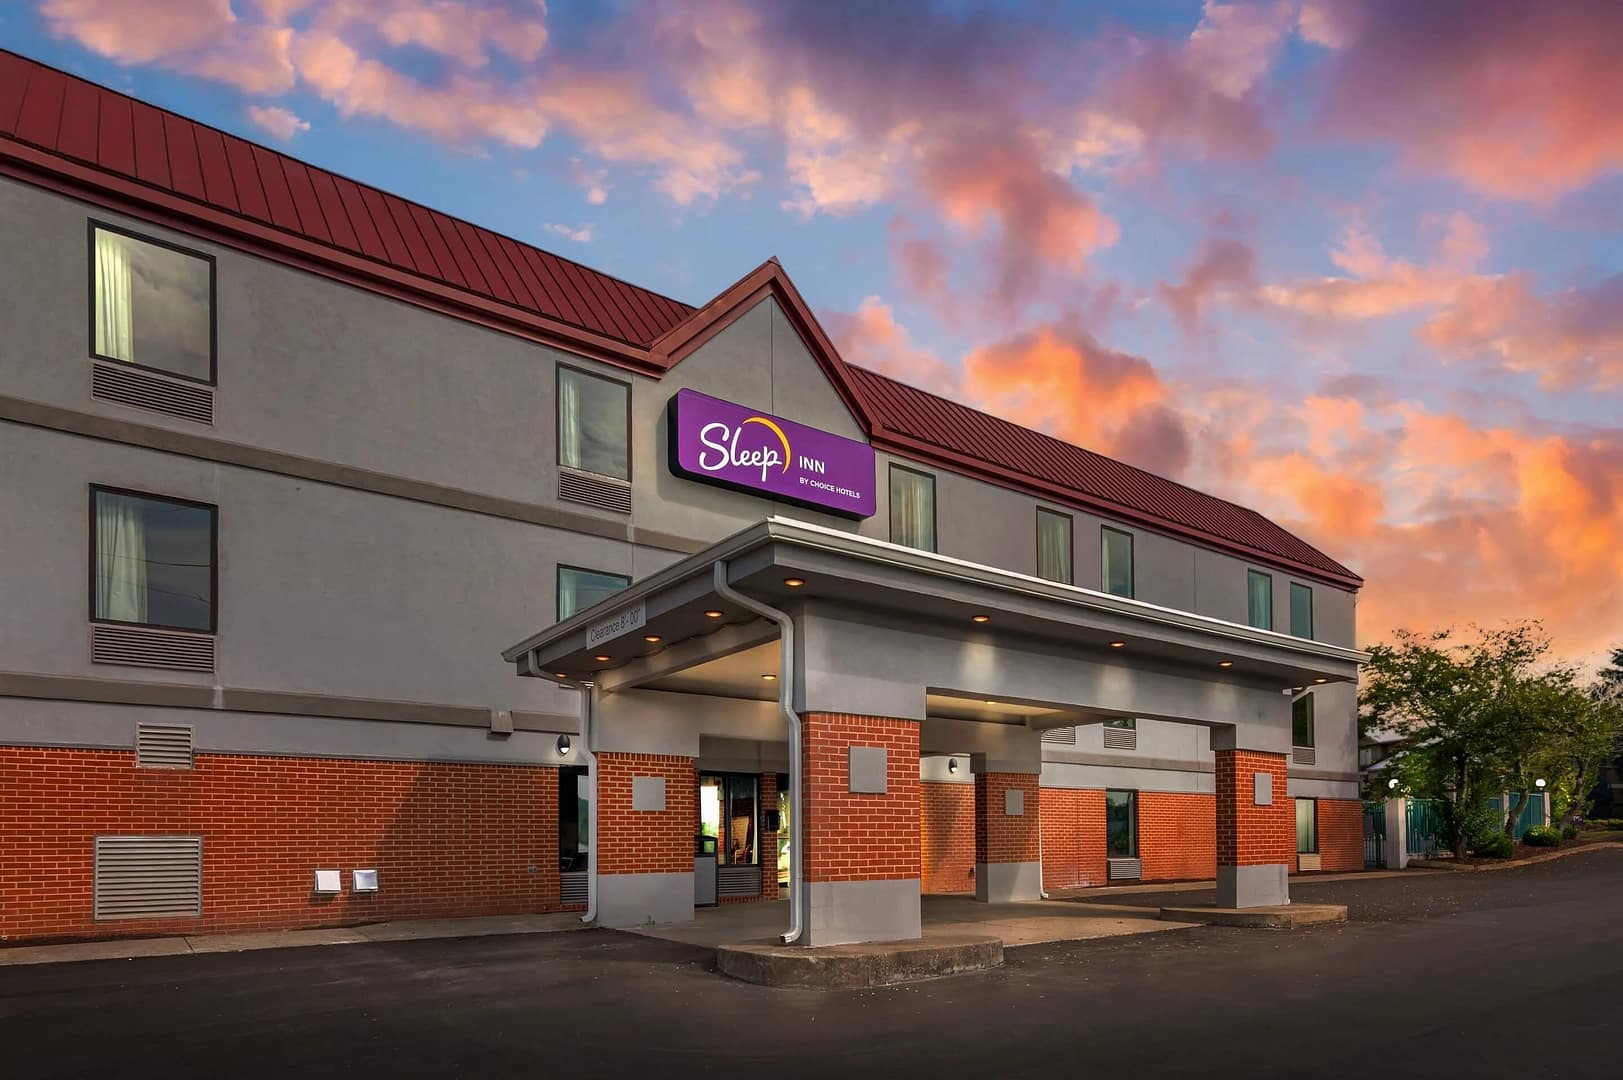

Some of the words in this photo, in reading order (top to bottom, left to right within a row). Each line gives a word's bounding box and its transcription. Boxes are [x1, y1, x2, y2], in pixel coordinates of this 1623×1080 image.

[699, 422, 783, 482] Sleep
[799, 455, 825, 475] INN
[799, 477, 809, 486] BY
[810, 479, 835, 493] CHOICE
[836, 486, 861, 499] HOTELS
[591, 621, 620, 642] Clearance
